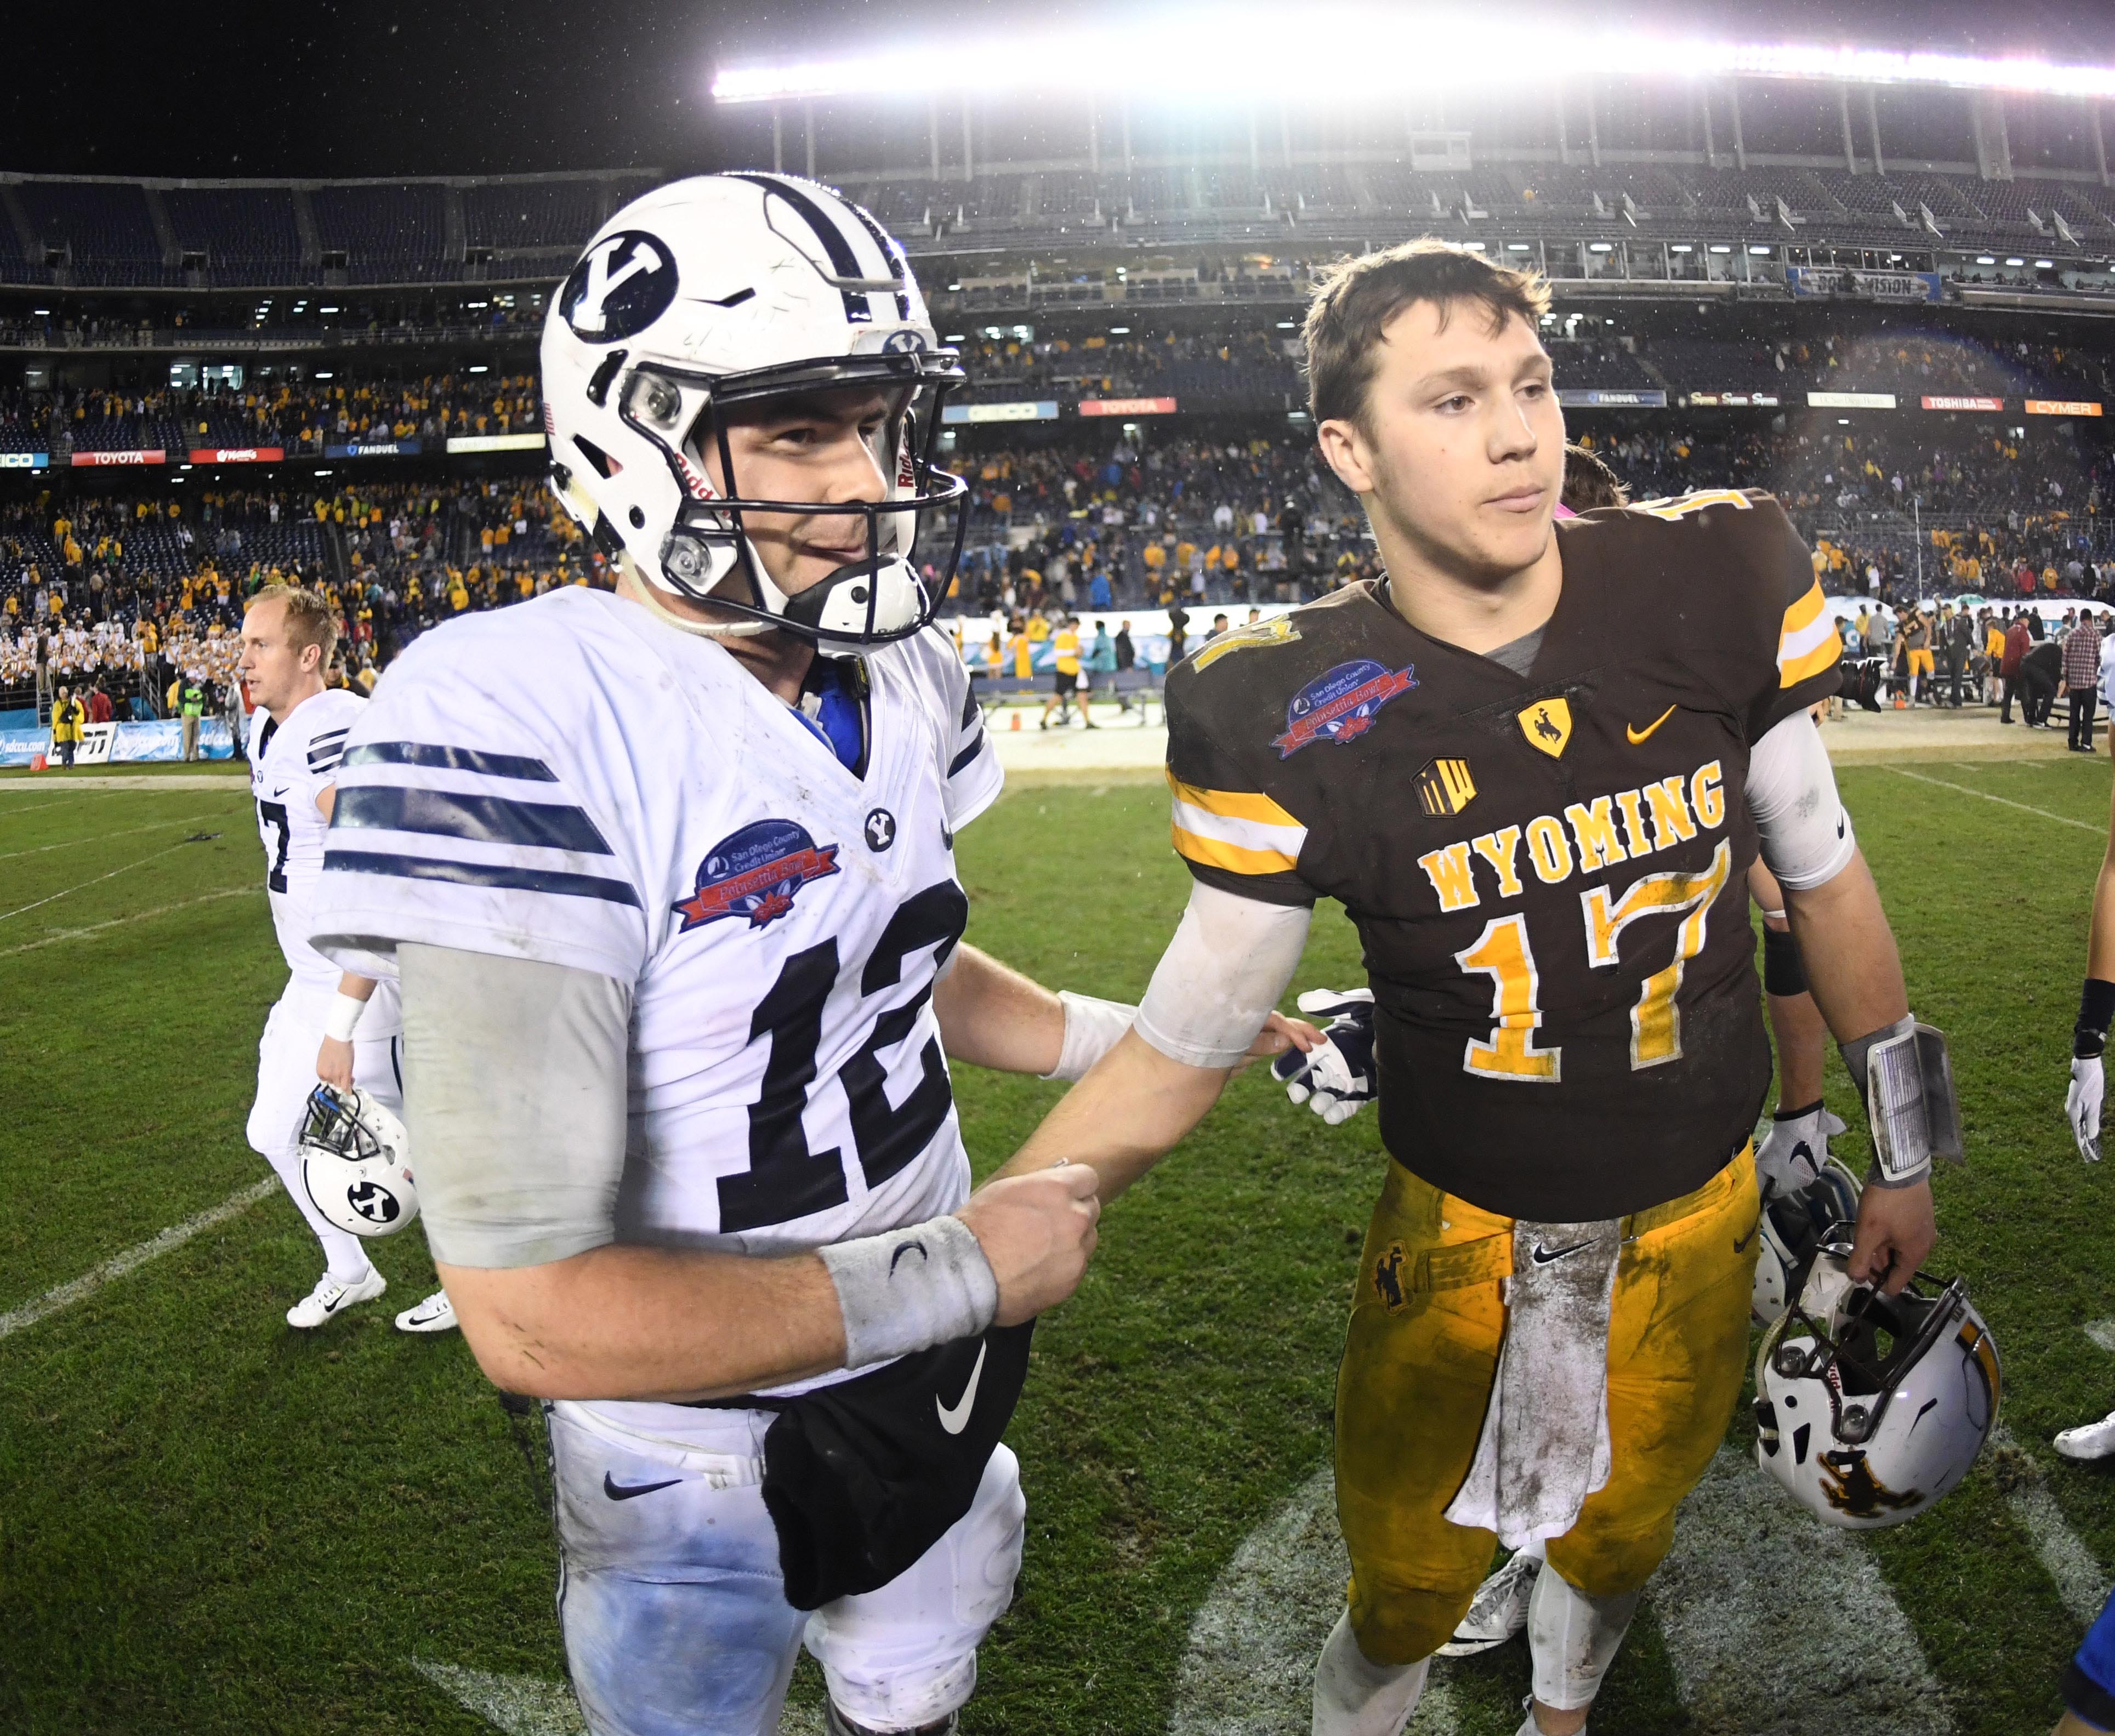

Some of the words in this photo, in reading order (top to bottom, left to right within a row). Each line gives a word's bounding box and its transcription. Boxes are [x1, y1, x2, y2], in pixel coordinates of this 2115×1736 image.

[572, 237, 663, 332] Y
[1929, 397, 1977, 409] TOSHIBA
[2036, 401, 2092, 415] CYMER
[0, 453, 34, 468] ICO
[93, 452, 144, 465] TOYOTA
[358, 444, 399, 454] FANDUEL
[1311, 690, 1324, 701] San
[1324, 678, 1346, 693] Diego
[1346, 663, 1371, 680] County
[1314, 692, 1336, 707] Credit
[5, 739, 46, 753] sdccu.com
[254, 795, 291, 895] 7
[731, 851, 748, 862] San
[774, 828, 800, 846] County
[868, 812, 890, 845] Y
[1417, 760, 1725, 913] WYOMING
[1451, 836, 1730, 1083] 17
[717, 878, 968, 1233] 12
[352, 1187, 390, 1221] Y
